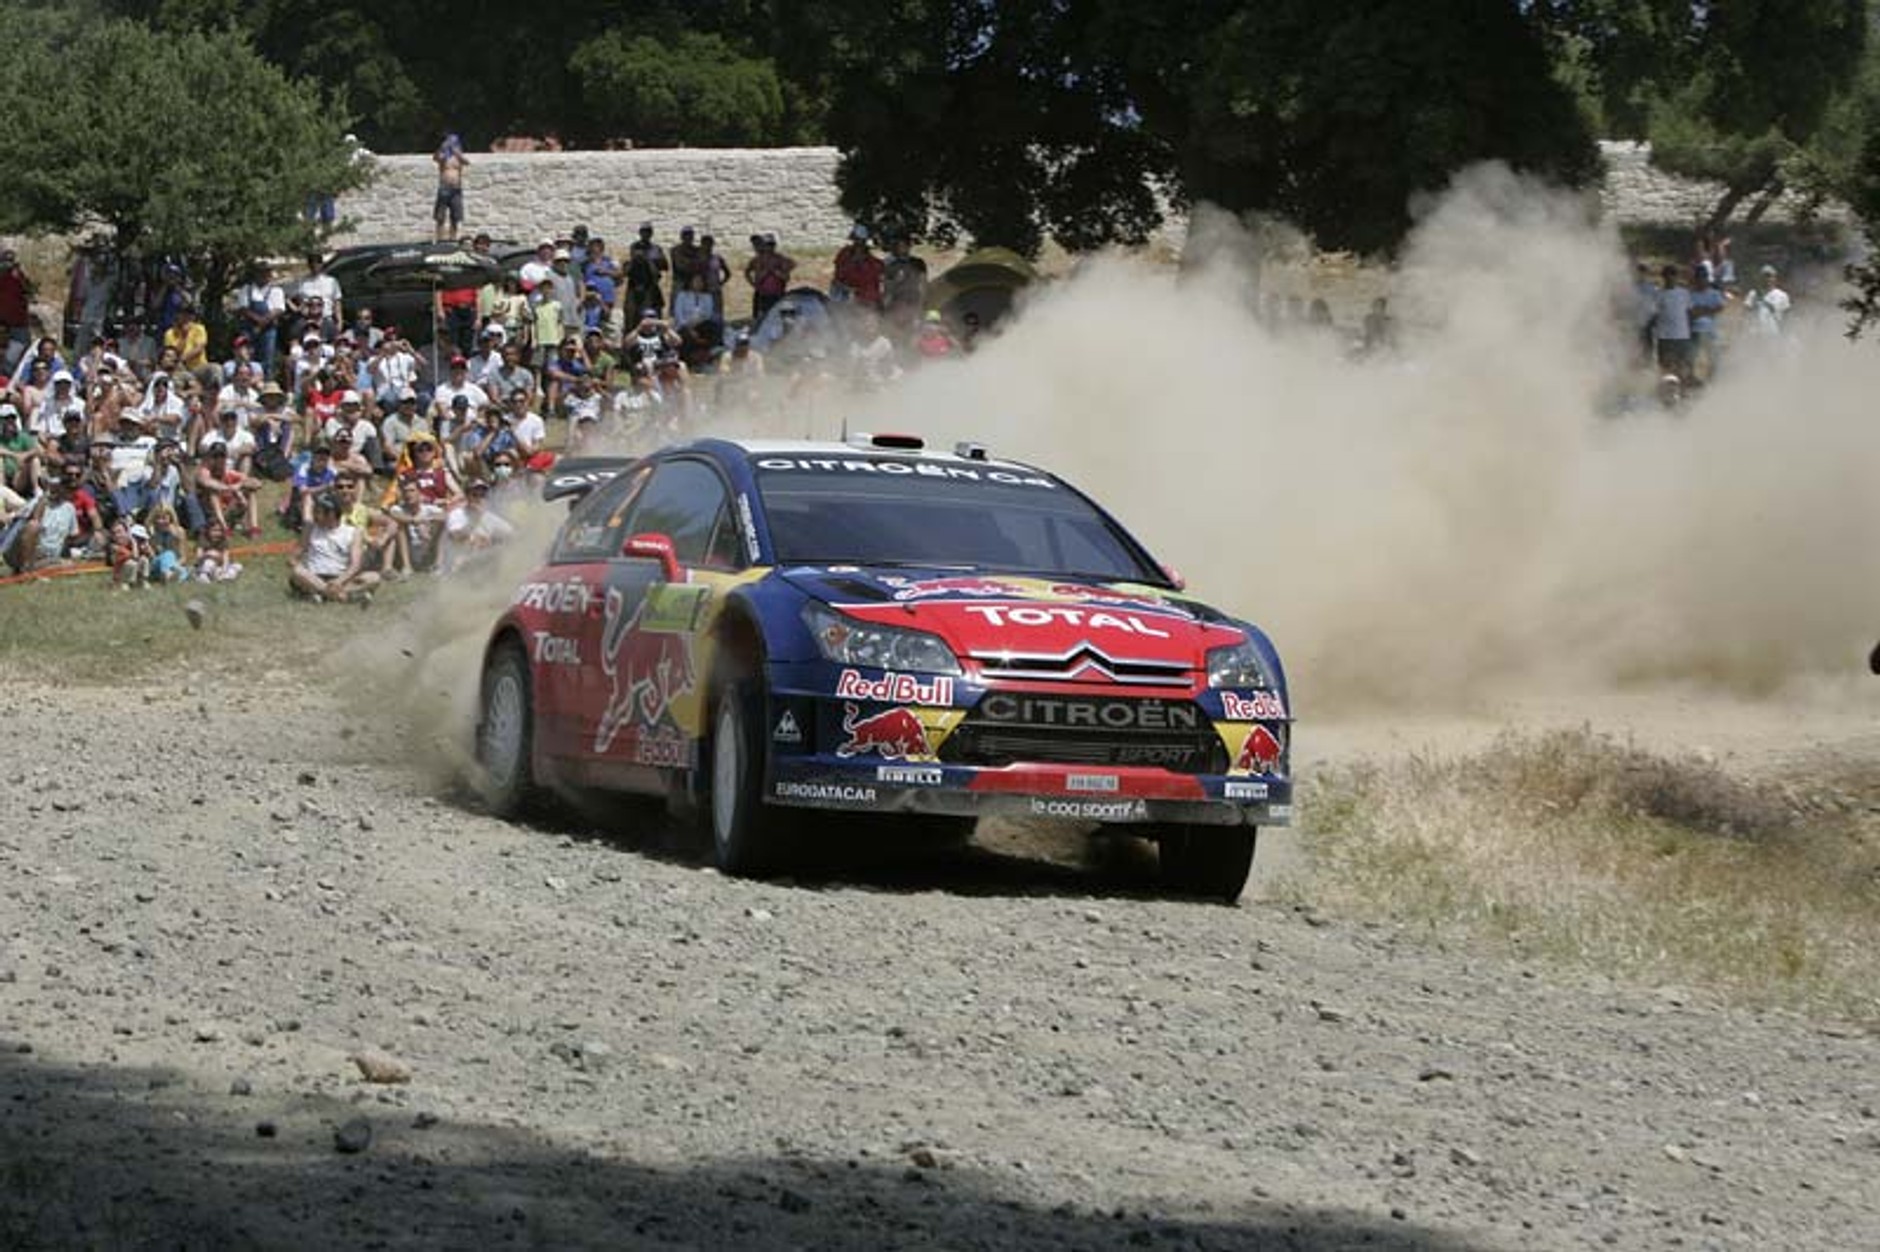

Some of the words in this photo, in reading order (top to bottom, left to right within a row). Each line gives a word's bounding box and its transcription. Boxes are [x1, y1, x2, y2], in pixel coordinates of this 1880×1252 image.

[965, 605, 1170, 638] TOTAL
[534, 631, 581, 664] TOTAL
[836, 668, 895, 701] Red
[893, 674, 953, 706] Bull
[979, 696, 1198, 729] CITROËN
[775, 781, 877, 801] EURODATACAR
